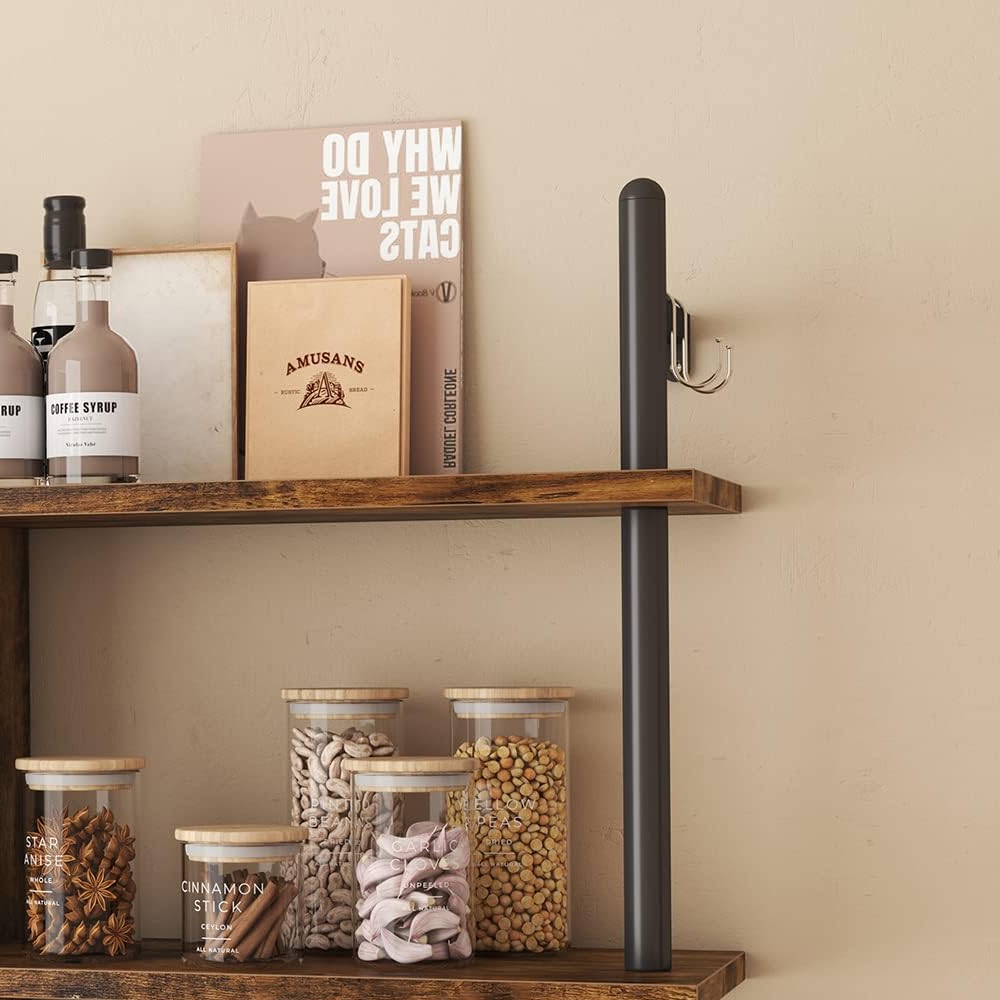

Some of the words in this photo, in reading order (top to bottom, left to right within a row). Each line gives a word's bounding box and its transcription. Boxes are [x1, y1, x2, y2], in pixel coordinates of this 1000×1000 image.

[286, 351, 365, 376] AMUSANS
[51, 402, 79, 415] COFFEE
[83, 401, 118, 413] SYRUP
[478, 815, 522, 828] PEAS
[25, 836, 59, 849] STAR
[391, 840, 458, 852] GARLIC
[486, 838, 512, 846] DRIED
[23, 853, 63, 867] ANISE
[181, 880, 264, 895] CINNAMON
[403, 881, 450, 889] UNPEELED
[194, 899, 242, 913] STICK
[200, 923, 232, 931] CEYLON
